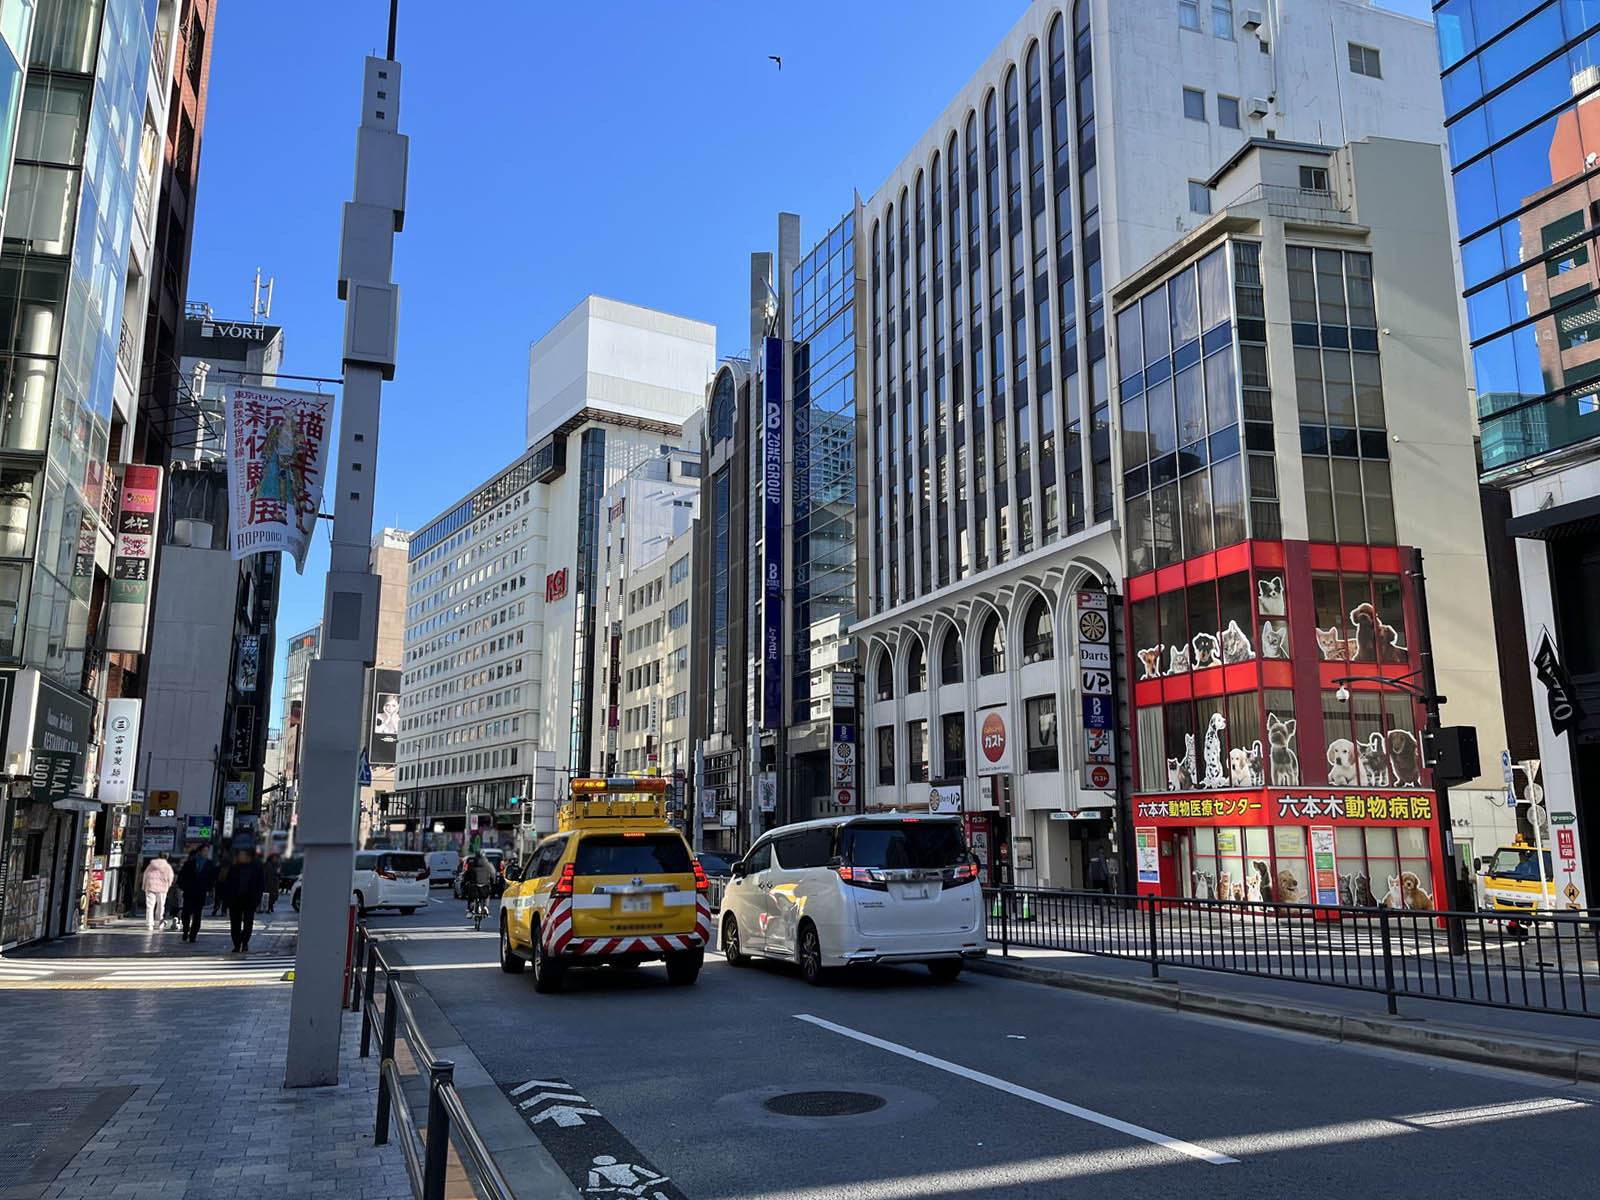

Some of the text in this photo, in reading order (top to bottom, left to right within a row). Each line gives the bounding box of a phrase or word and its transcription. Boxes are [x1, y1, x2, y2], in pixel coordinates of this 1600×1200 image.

[218, 325, 262, 339] VORT
[1080, 648, 1109, 661] Darts
[1083, 671, 1110, 692] UP
[984, 733, 1004, 749] ガスト
[31, 756, 52, 788] FOOD
[49, 758, 71, 796] HALAL
[1138, 797, 1262, 818] 六本木動物医療センター
[1278, 794, 1432, 820] 六本木動物病院
